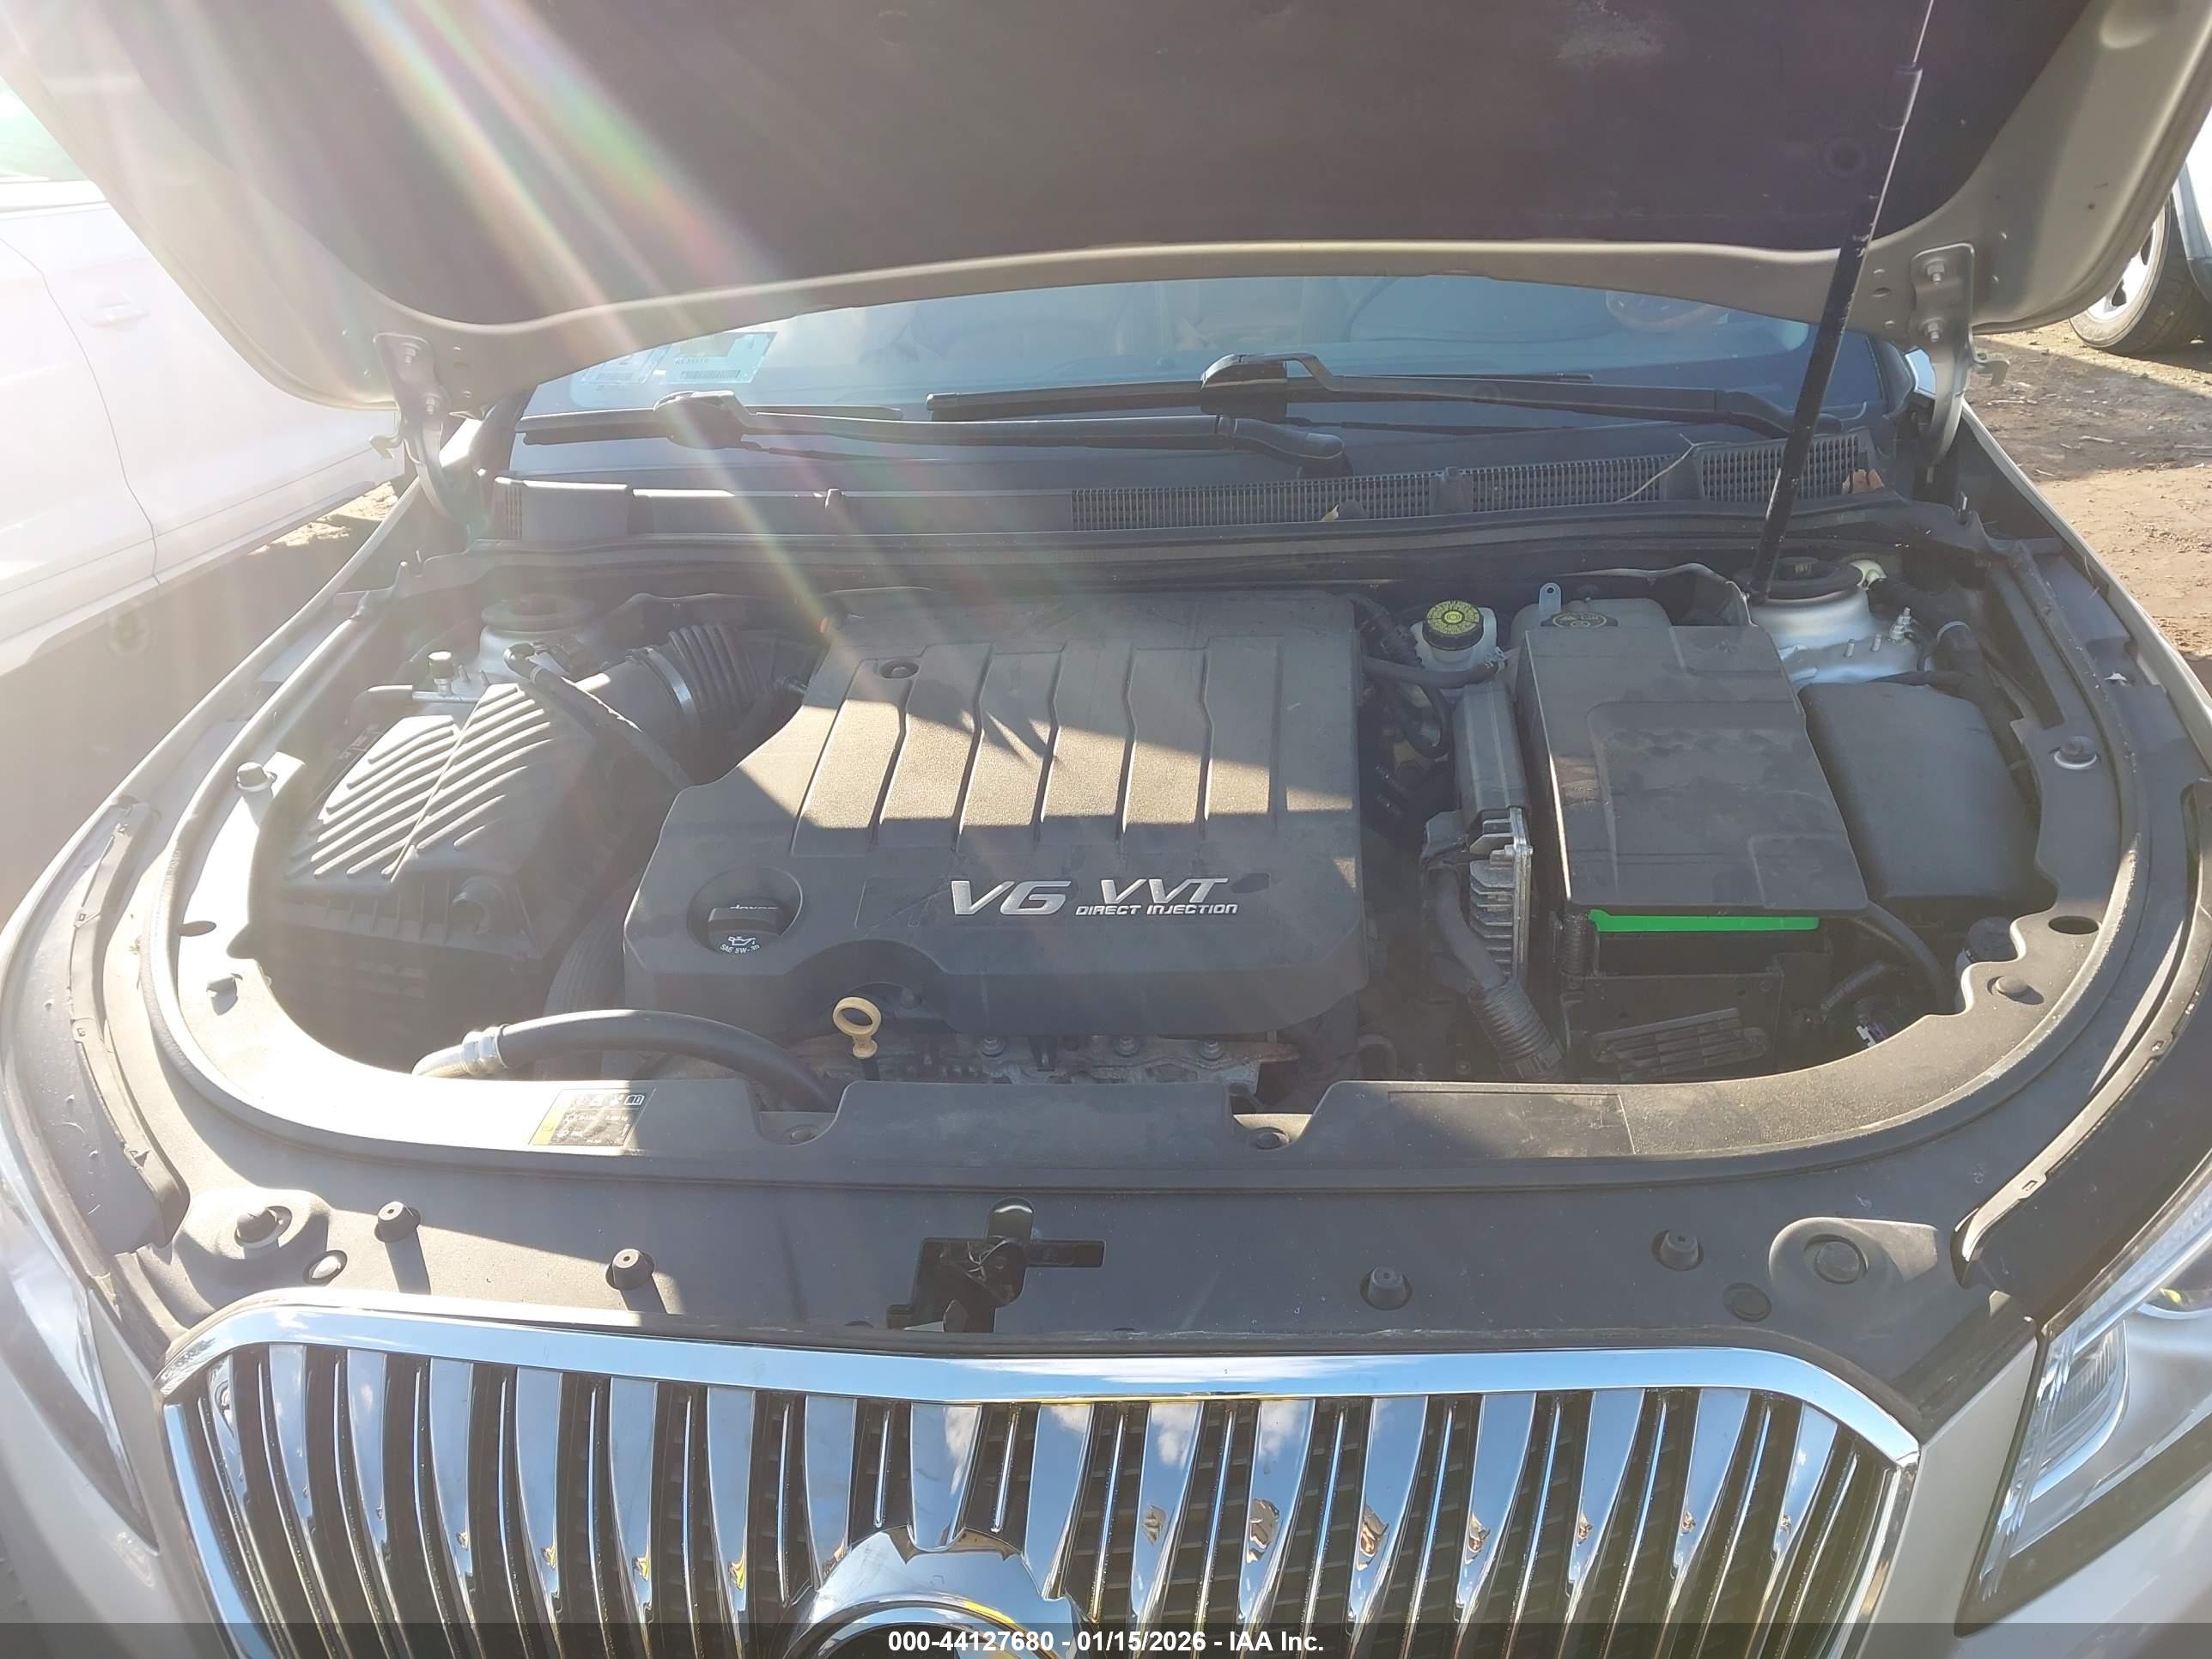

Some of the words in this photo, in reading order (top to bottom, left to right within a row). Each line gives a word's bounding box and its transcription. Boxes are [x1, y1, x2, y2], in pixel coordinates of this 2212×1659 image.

[951, 880, 1072, 915] V6
[1100, 878, 1229, 905] VVT
[1075, 904, 1142, 915] DIRECT
[1146, 904, 1238, 915] INJECTION
[720, 944, 733, 953] SAE
